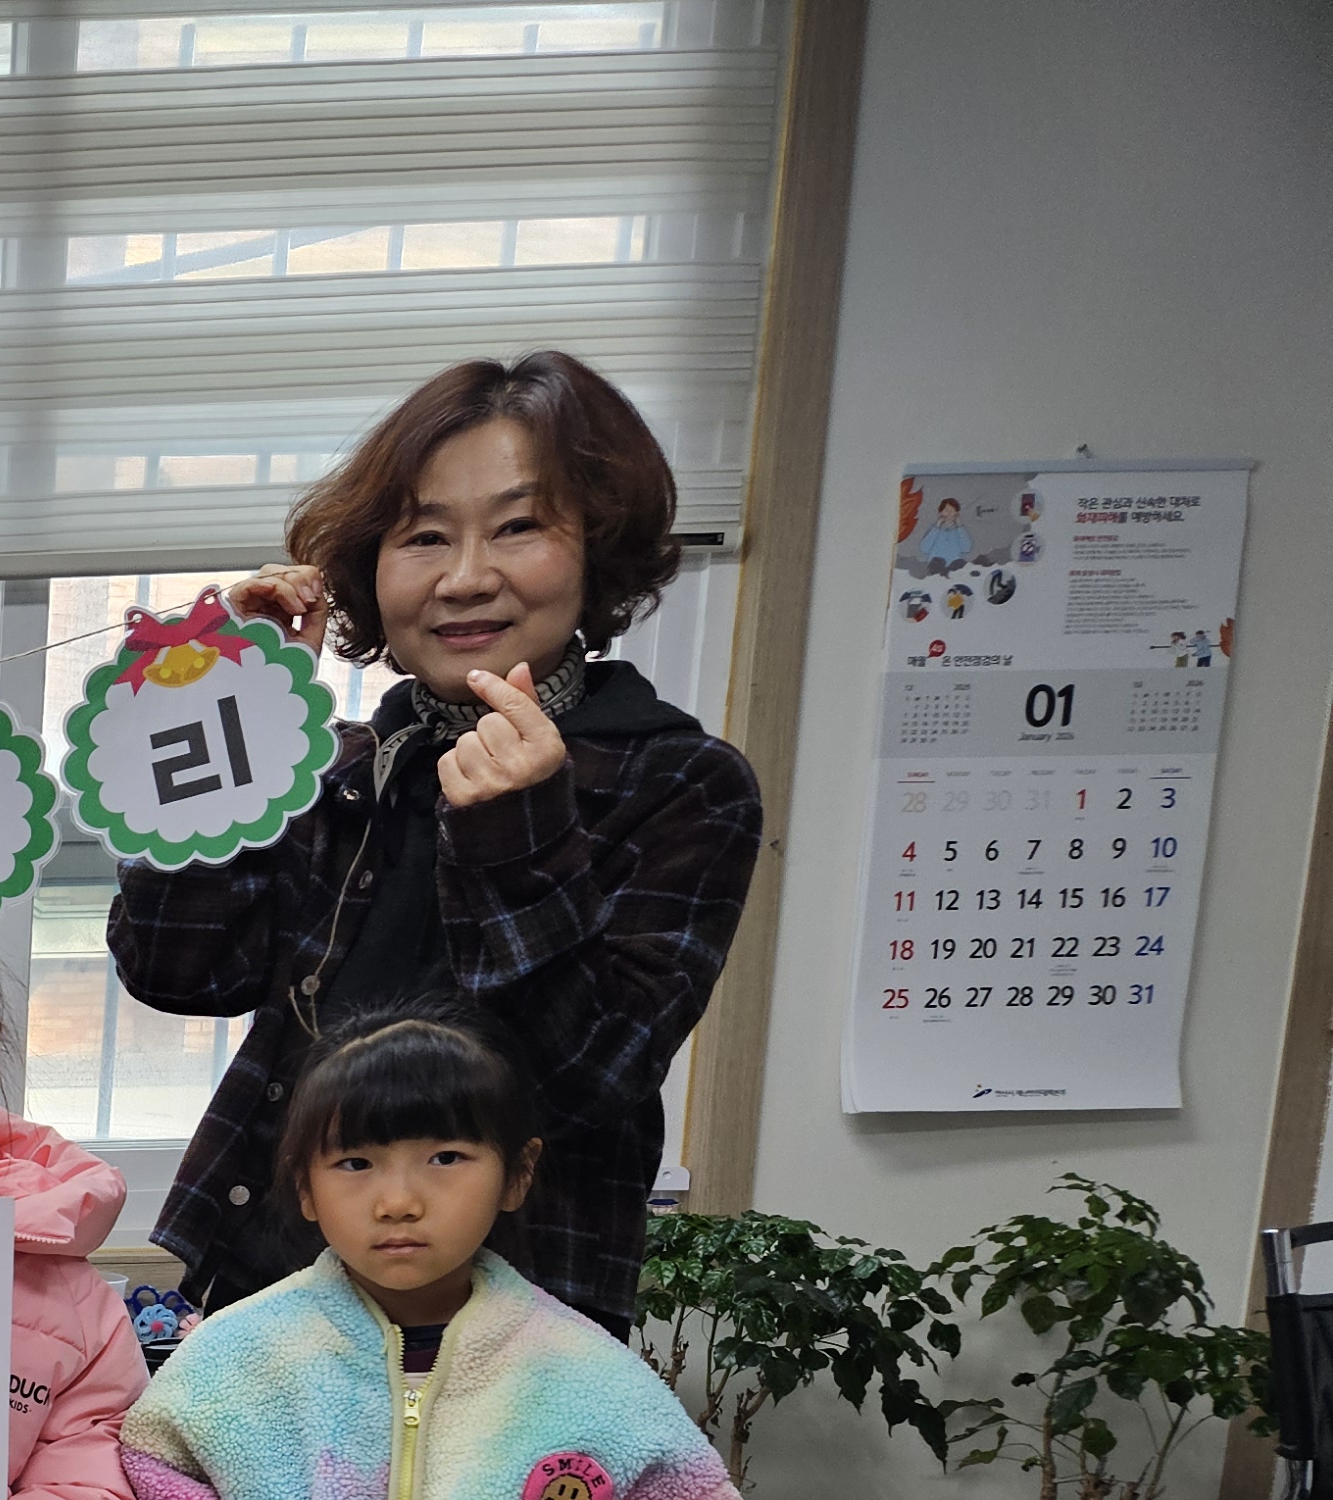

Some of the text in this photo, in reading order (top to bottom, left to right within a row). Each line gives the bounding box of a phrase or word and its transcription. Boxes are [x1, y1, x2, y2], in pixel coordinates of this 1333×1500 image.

[1025, 683, 1075, 728] 01
[1076, 788, 1087, 810] 1
[1116, 788, 1133, 810] 2
[1160, 788, 1177, 809] 3
[902, 837, 1177, 862] 4 5 6 7 8 9 10
[894, 887, 1171, 911] 11 12 13 14 15 16 17
[890, 936, 1164, 960] 18 19 20 21 22 23 24
[882, 984, 1154, 1009] 25 26 27 28 29 30 31
